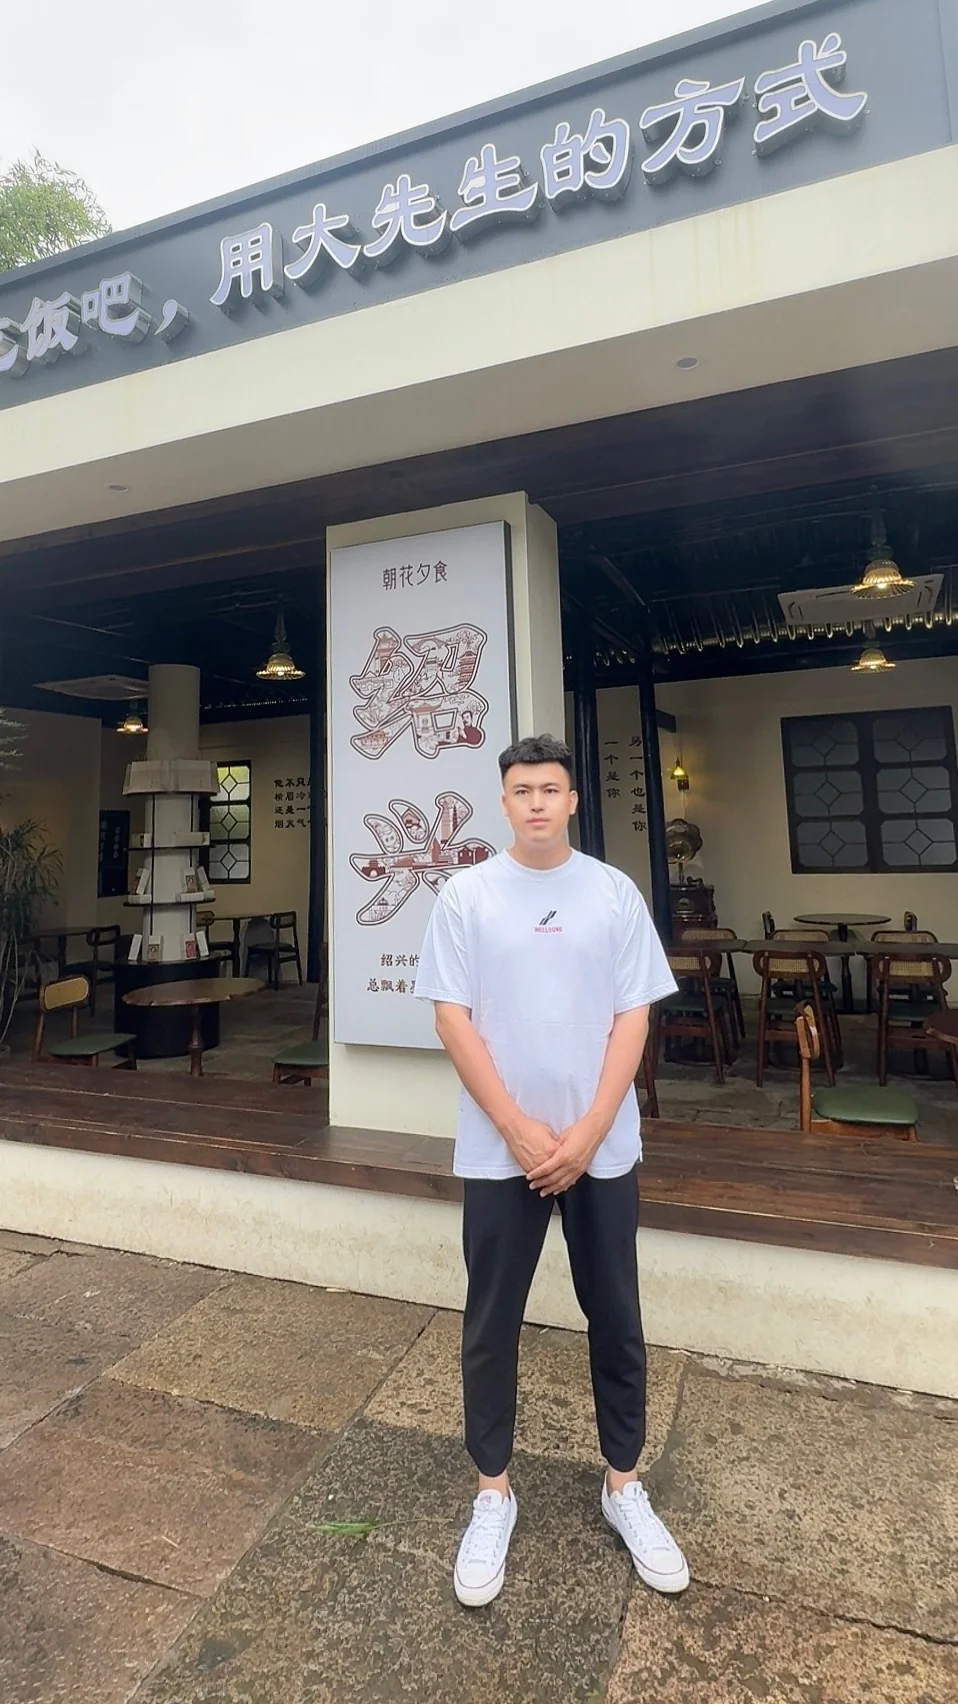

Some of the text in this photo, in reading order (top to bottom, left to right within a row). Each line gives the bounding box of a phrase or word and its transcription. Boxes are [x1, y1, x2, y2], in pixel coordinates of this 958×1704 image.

[382, 560, 449, 591] 朝花夕食
[604, 741, 621, 798] 一个是你
[628, 735, 647, 832] 另一个也是你
[274, 818, 311, 829] 烟火气
